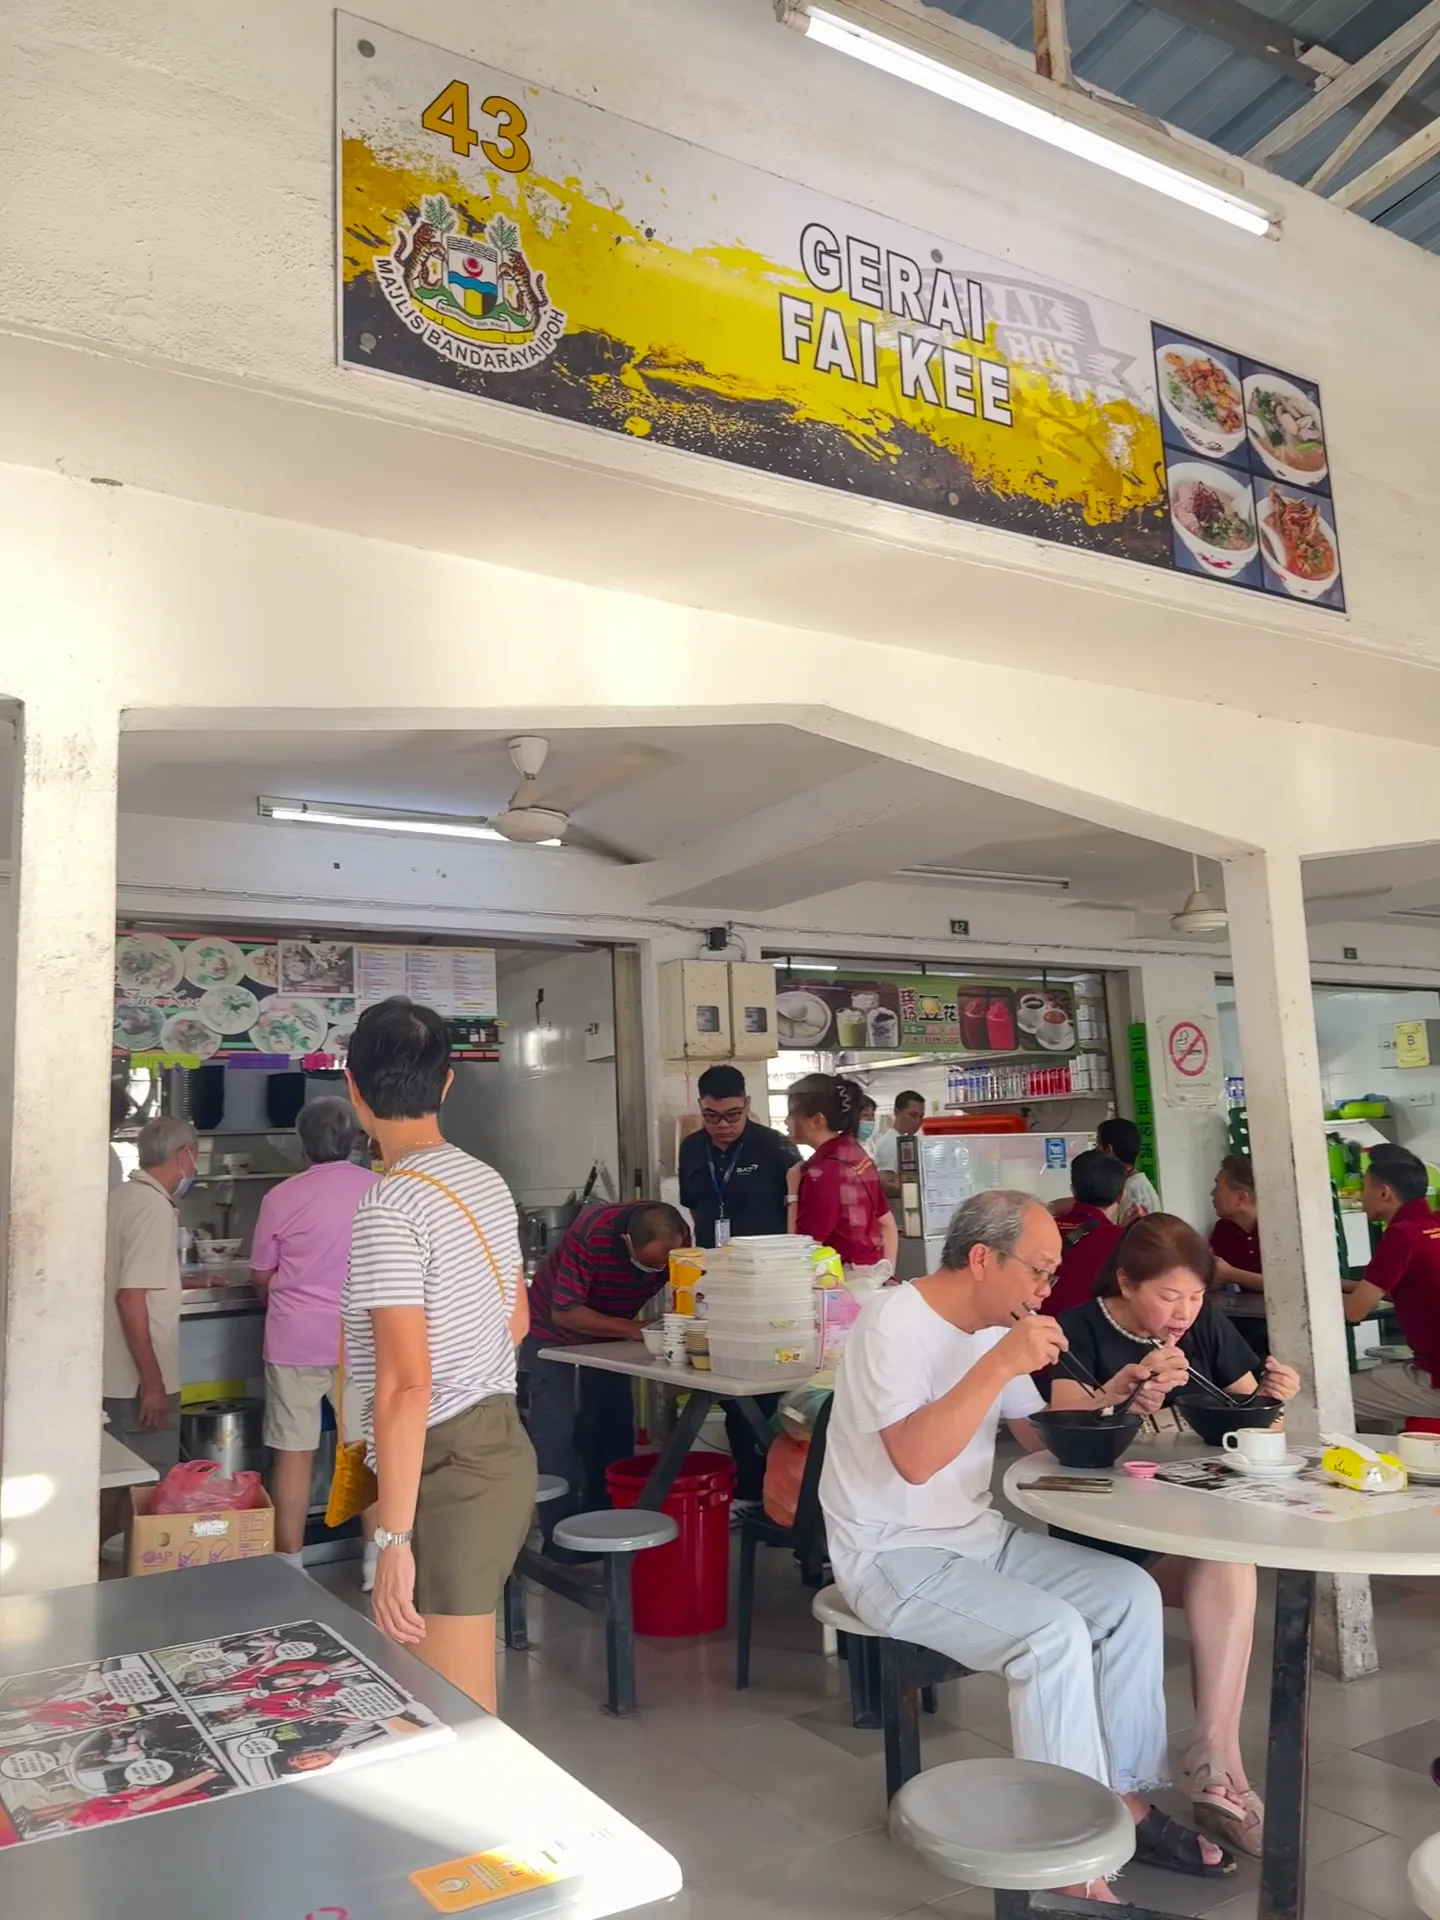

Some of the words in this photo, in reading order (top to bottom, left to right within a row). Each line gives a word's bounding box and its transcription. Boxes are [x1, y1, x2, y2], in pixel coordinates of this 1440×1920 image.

[421, 79, 532, 174] 43
[376, 258, 425, 331] MAJLIS
[426, 328, 542, 370] BANDARAYA
[541, 308, 566, 351] IPOH
[800, 222, 987, 345] GERAI
[779, 292, 879, 389] FAI
[898, 331, 1014, 428] KEE
[954, 921, 966, 933] 42
[1406, 1035, 1416, 1046] B
